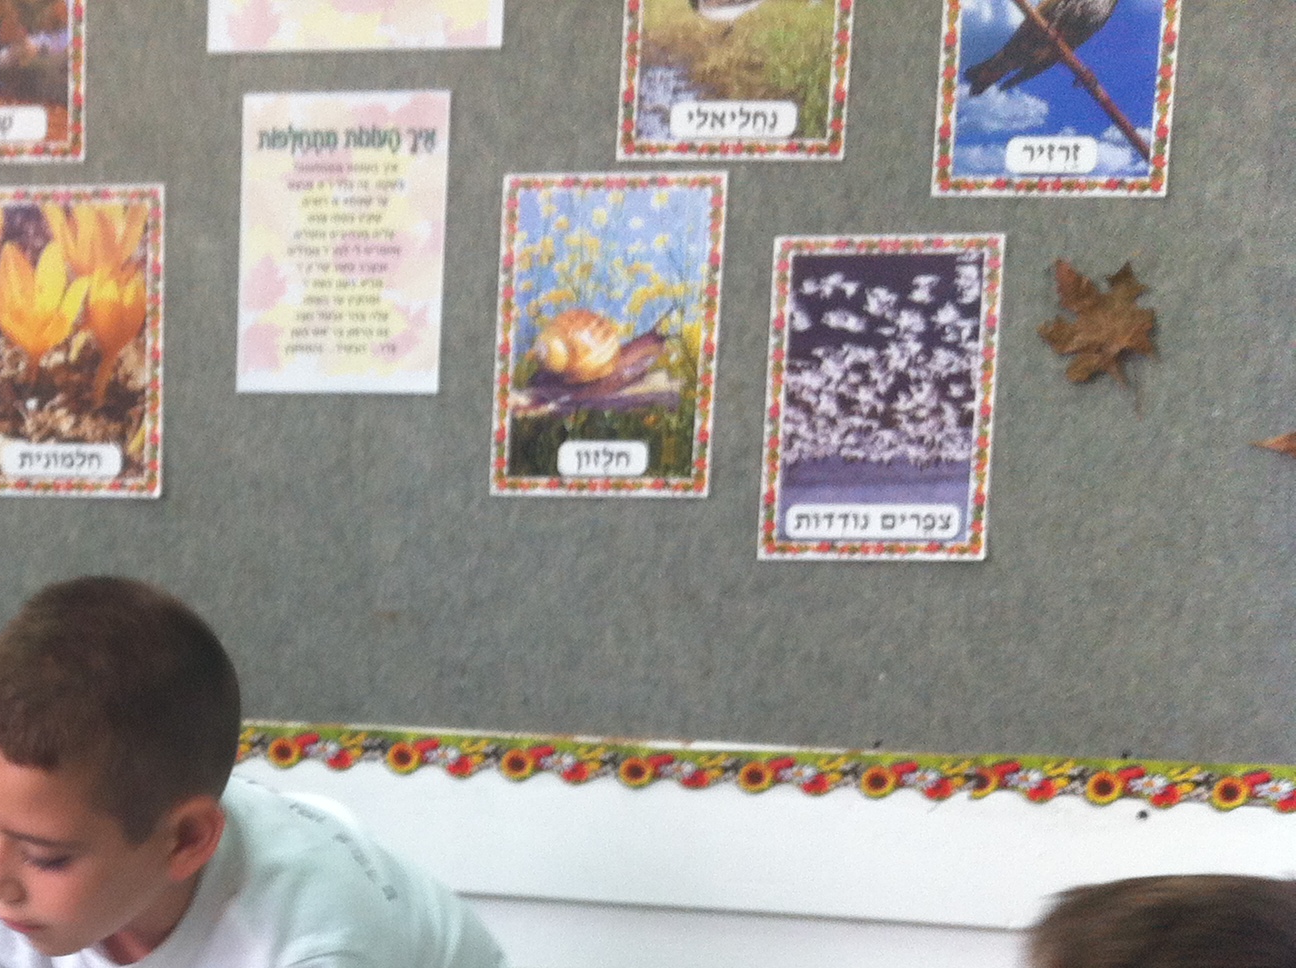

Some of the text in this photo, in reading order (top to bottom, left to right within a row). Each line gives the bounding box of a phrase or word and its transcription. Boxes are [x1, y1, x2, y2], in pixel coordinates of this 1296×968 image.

[687, 105, 778, 130] נחליאלי
[1022, 143, 1081, 162] זרזיר
[19, 447, 101, 470] חלמונית
[575, 446, 631, 472] חלזון
[794, 512, 951, 531] צפרים נודדות
